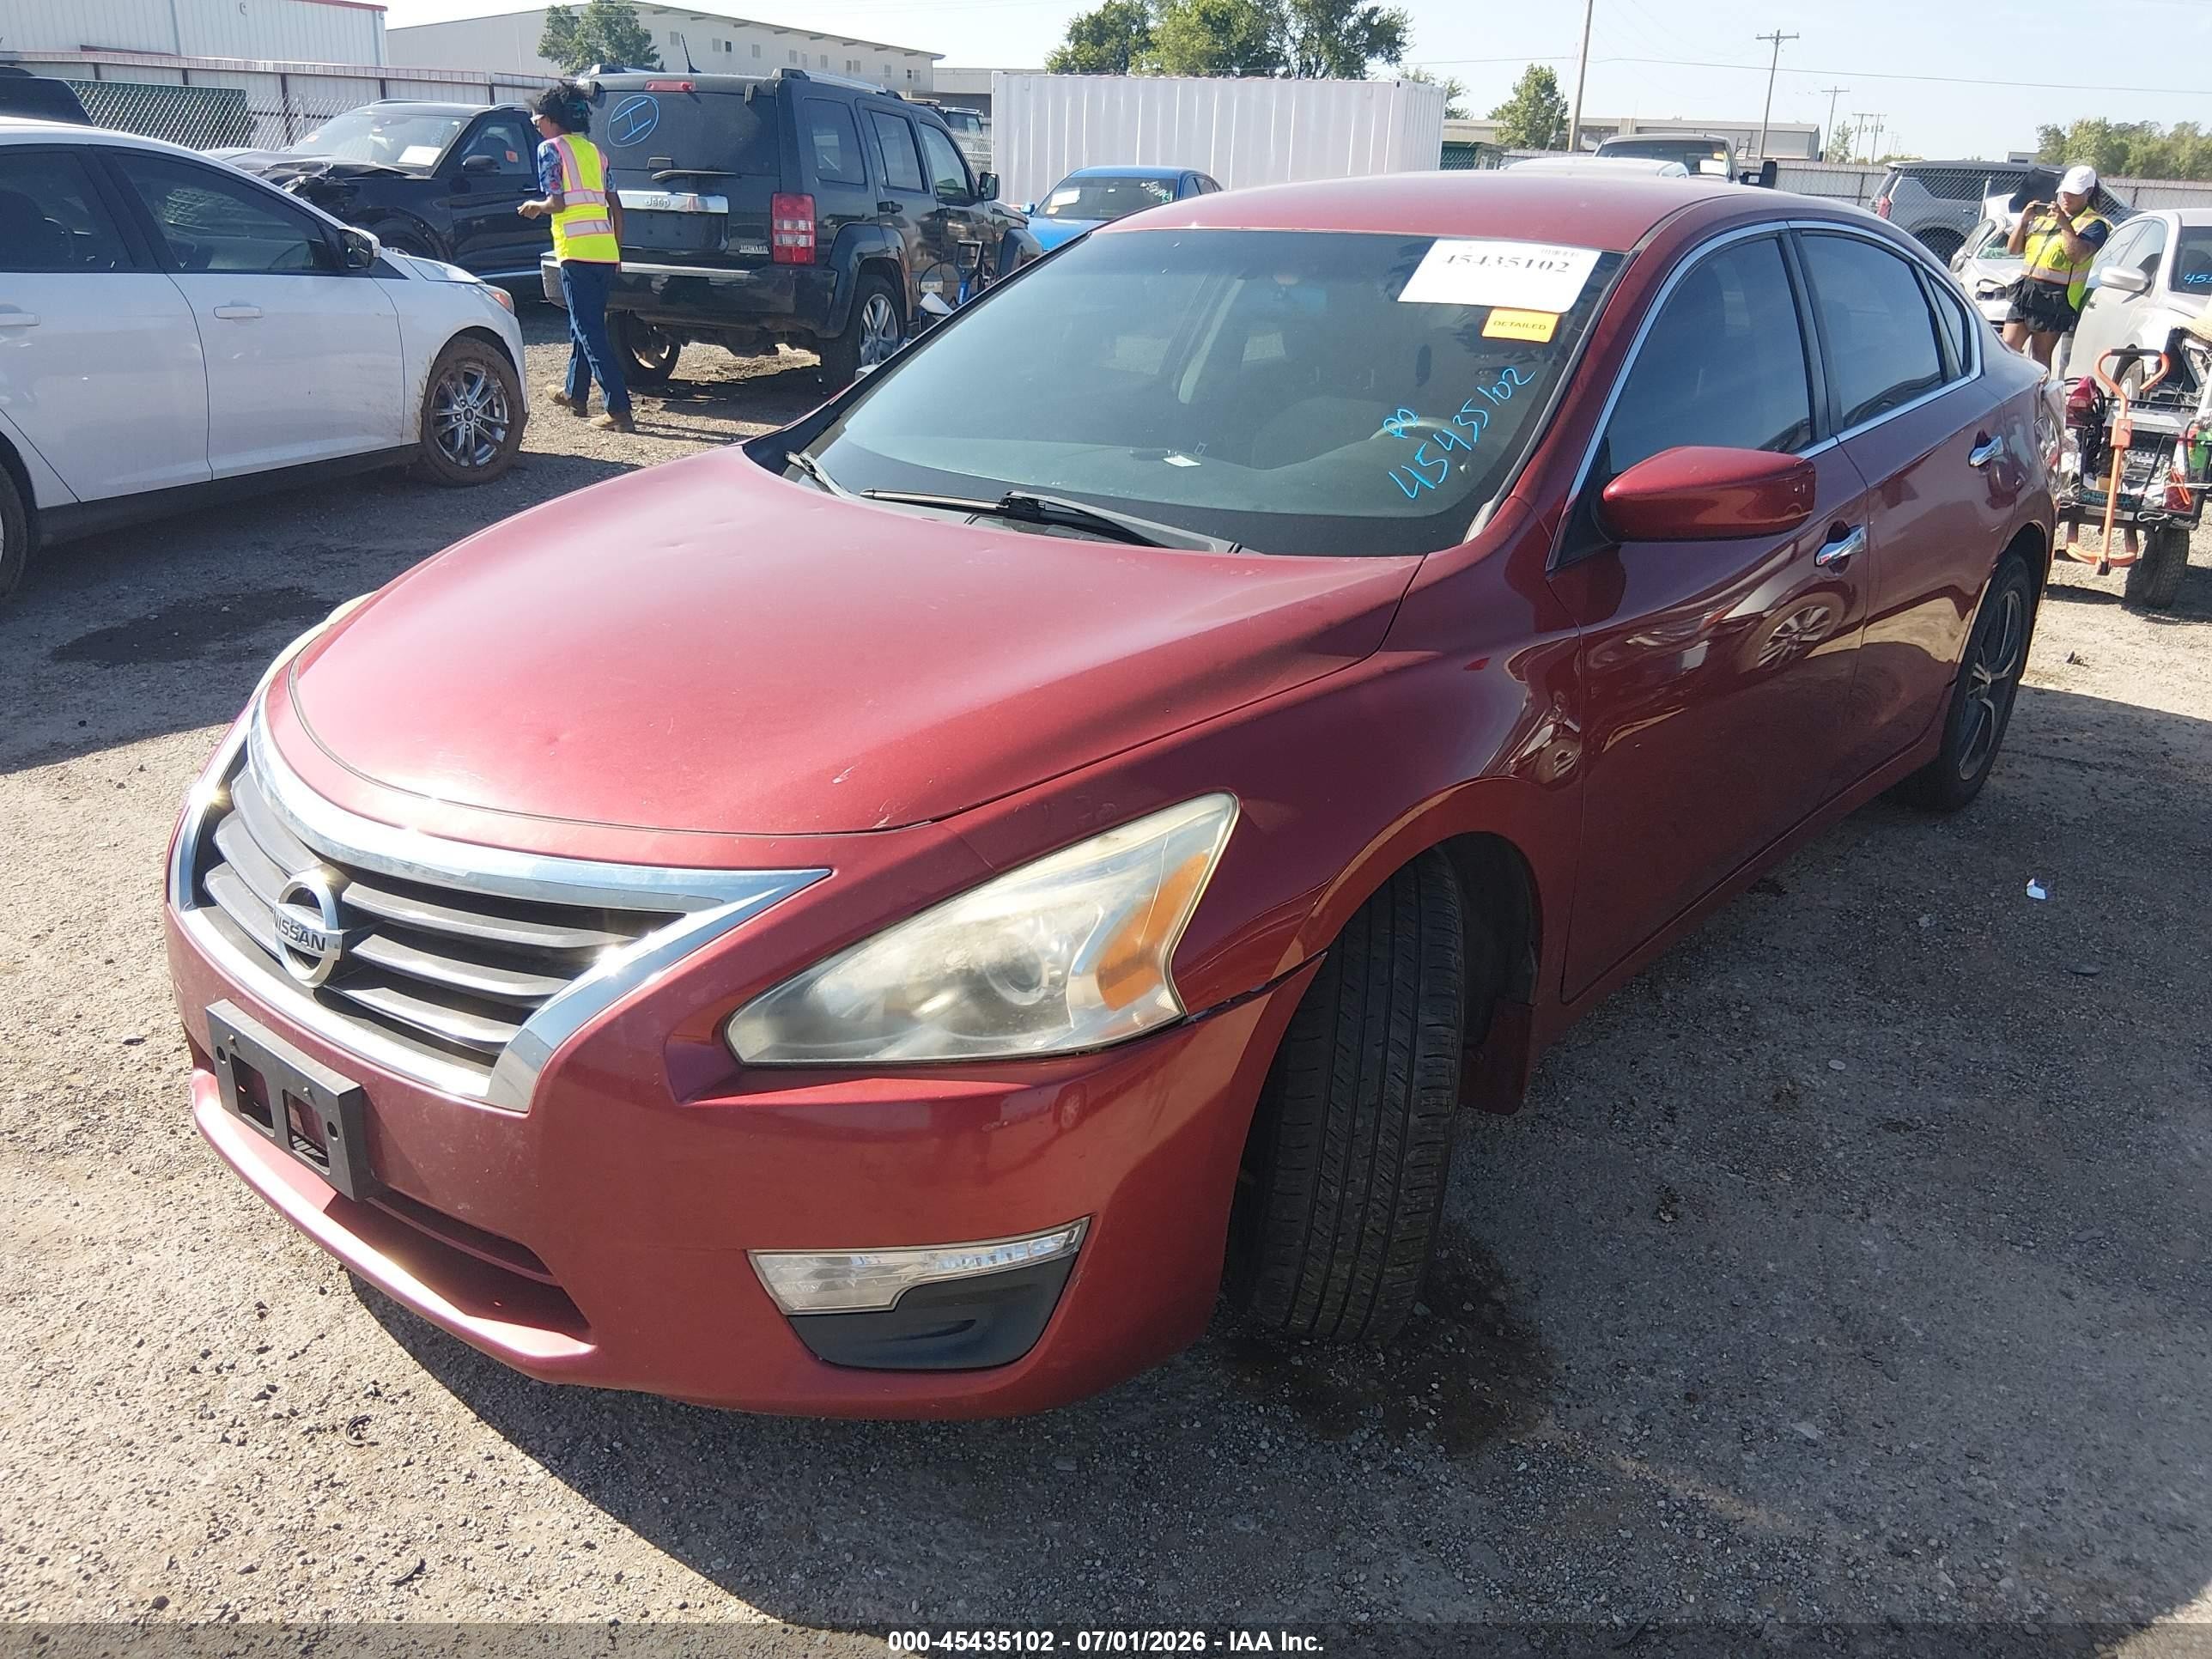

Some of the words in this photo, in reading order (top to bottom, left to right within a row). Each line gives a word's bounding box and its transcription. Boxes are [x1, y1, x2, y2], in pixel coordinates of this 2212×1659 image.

[645, 195, 671, 209] Jeep
[1443, 254, 1571, 273] 45435102
[1492, 320, 1547, 331] DETAILED
[1388, 367, 1537, 499] 45435102
[273, 910, 326, 952] NISSAN
